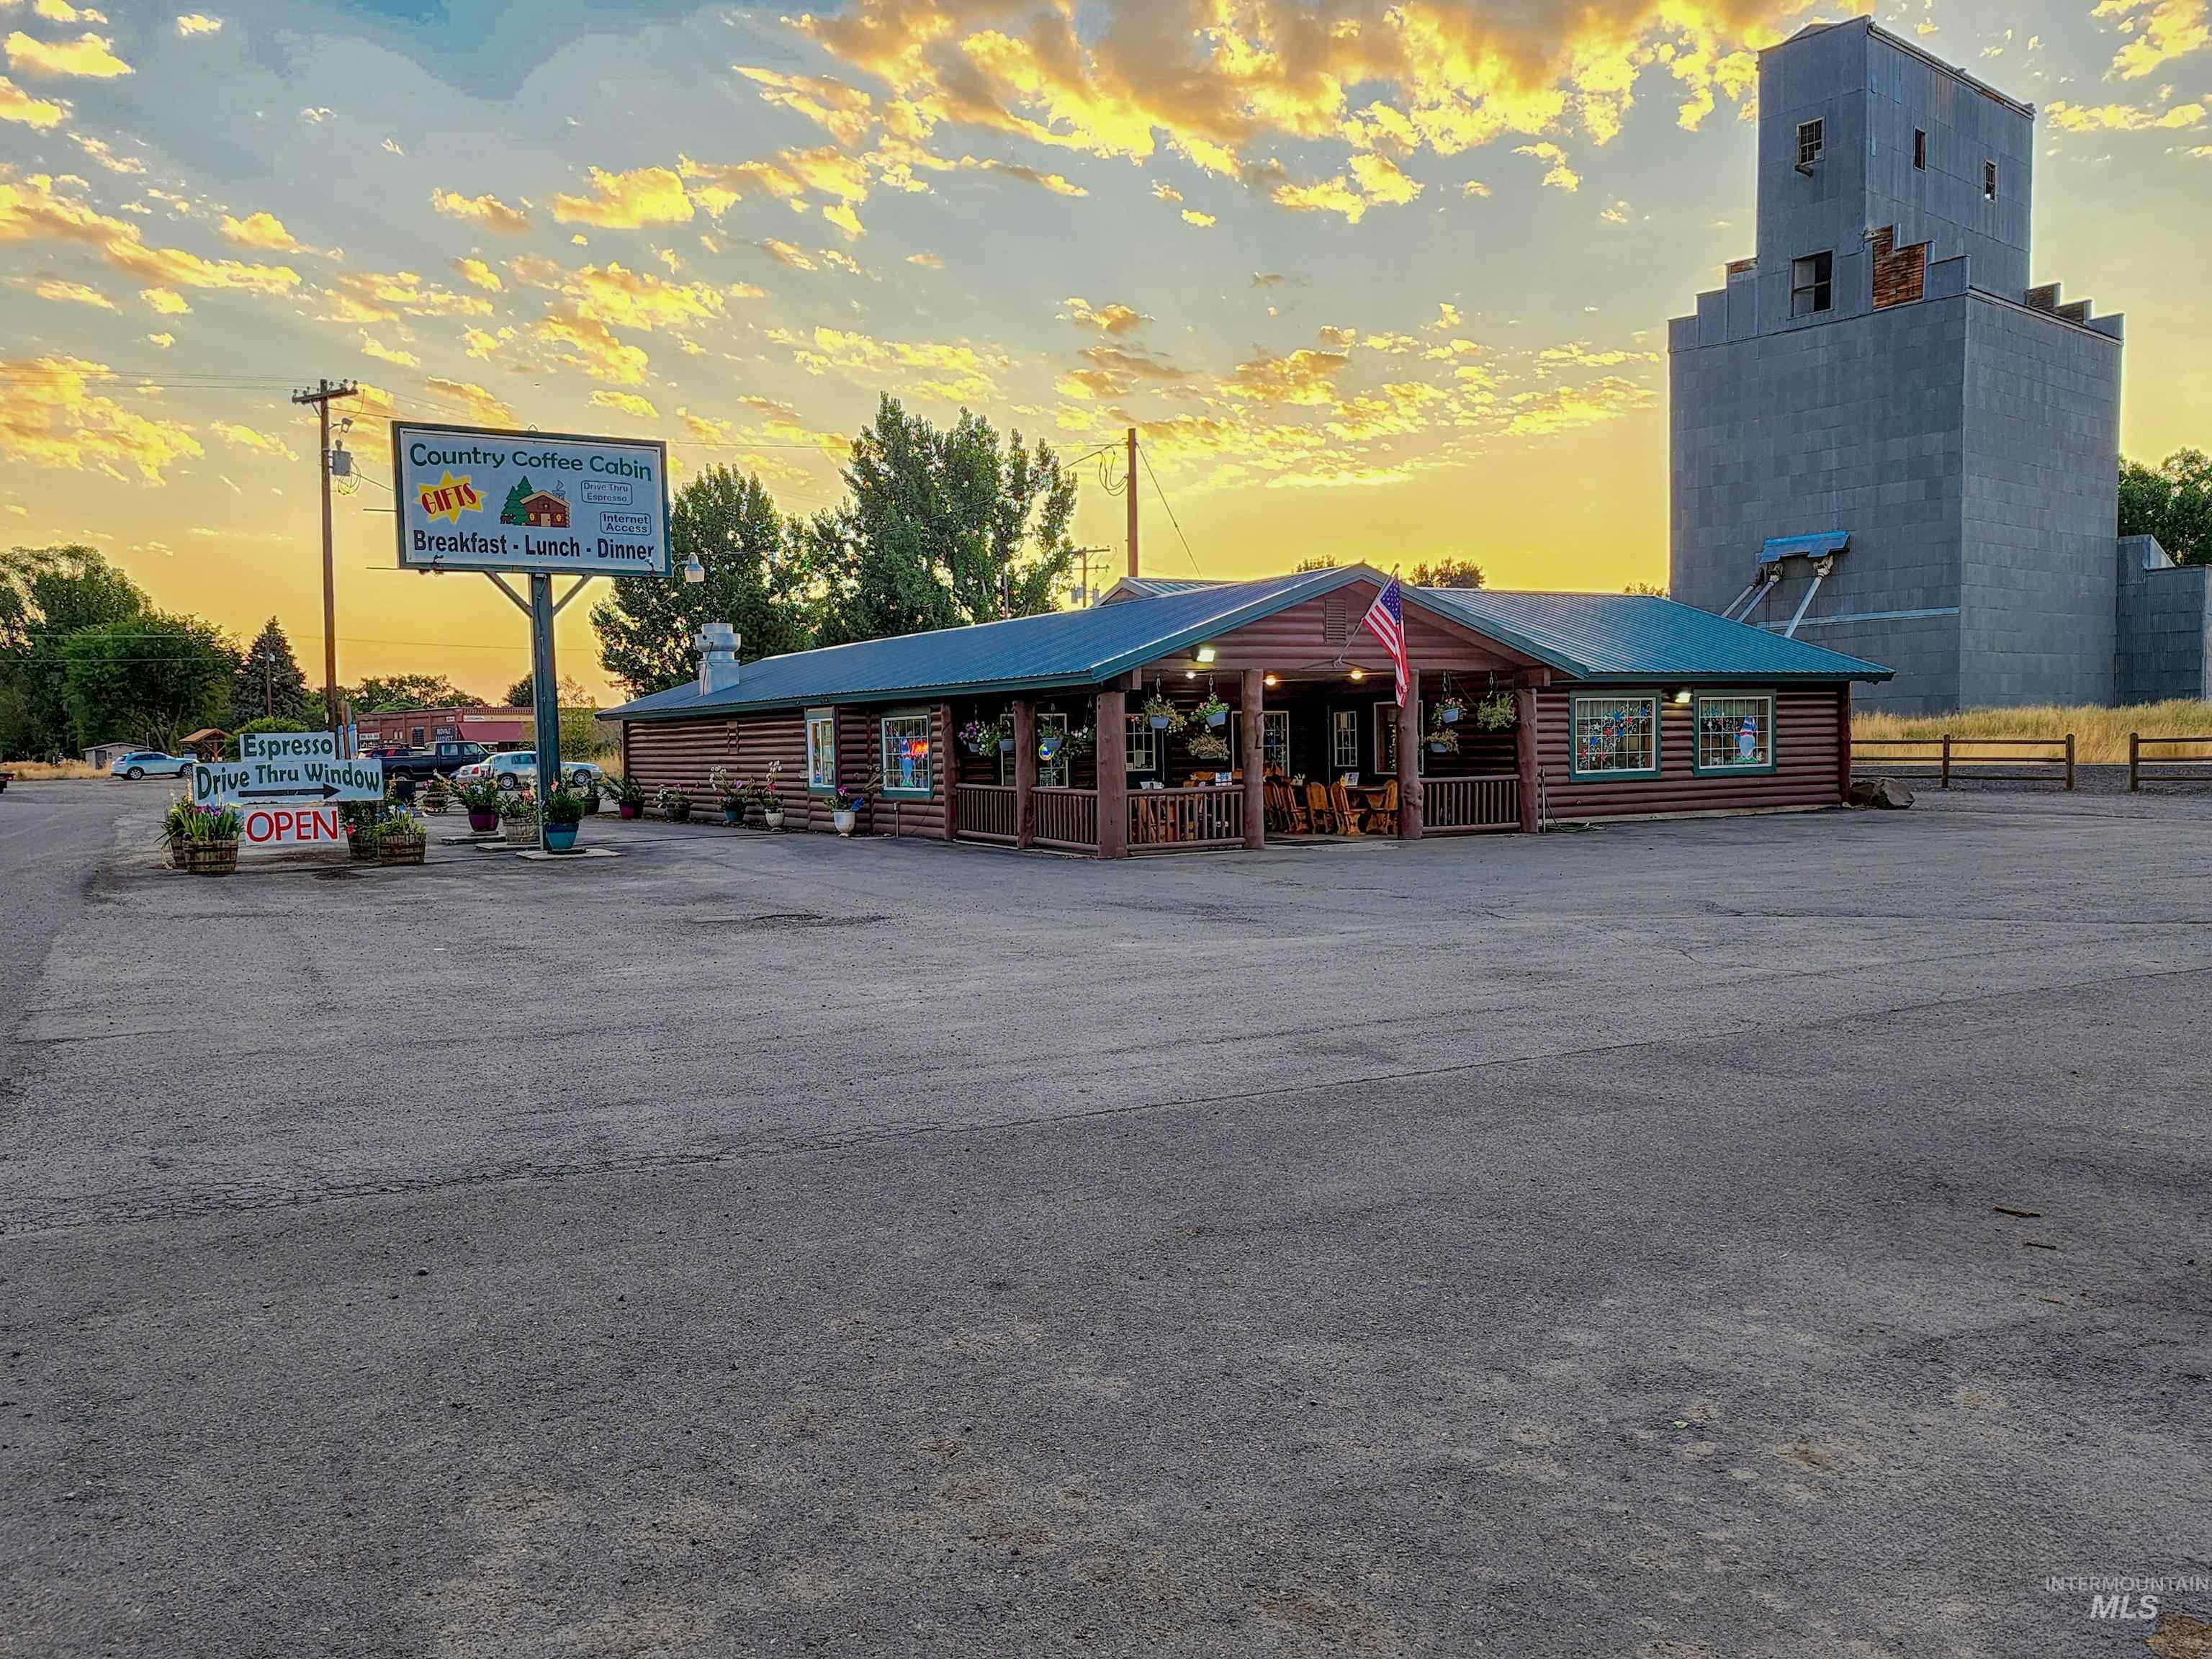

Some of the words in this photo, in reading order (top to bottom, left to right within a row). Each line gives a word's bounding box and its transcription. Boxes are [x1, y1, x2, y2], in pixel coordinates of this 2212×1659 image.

[410, 443, 505, 469] Country
[512, 451, 583, 470] Coffee
[589, 455, 652, 481] Cabin
[421, 482, 477, 514] GIFTS
[587, 493, 627, 502] Espresso
[603, 513, 648, 524] Internet
[606, 523, 647, 533] Access
[413, 530, 507, 554] Breakfast
[525, 534, 580, 557] Lunch
[597, 538, 655, 559] Dinner
[244, 734, 333, 760] Espresso
[196, 766, 249, 800] Drive
[256, 765, 299, 784] Thru
[305, 763, 379, 792] Window
[246, 810, 338, 842] OPEN
